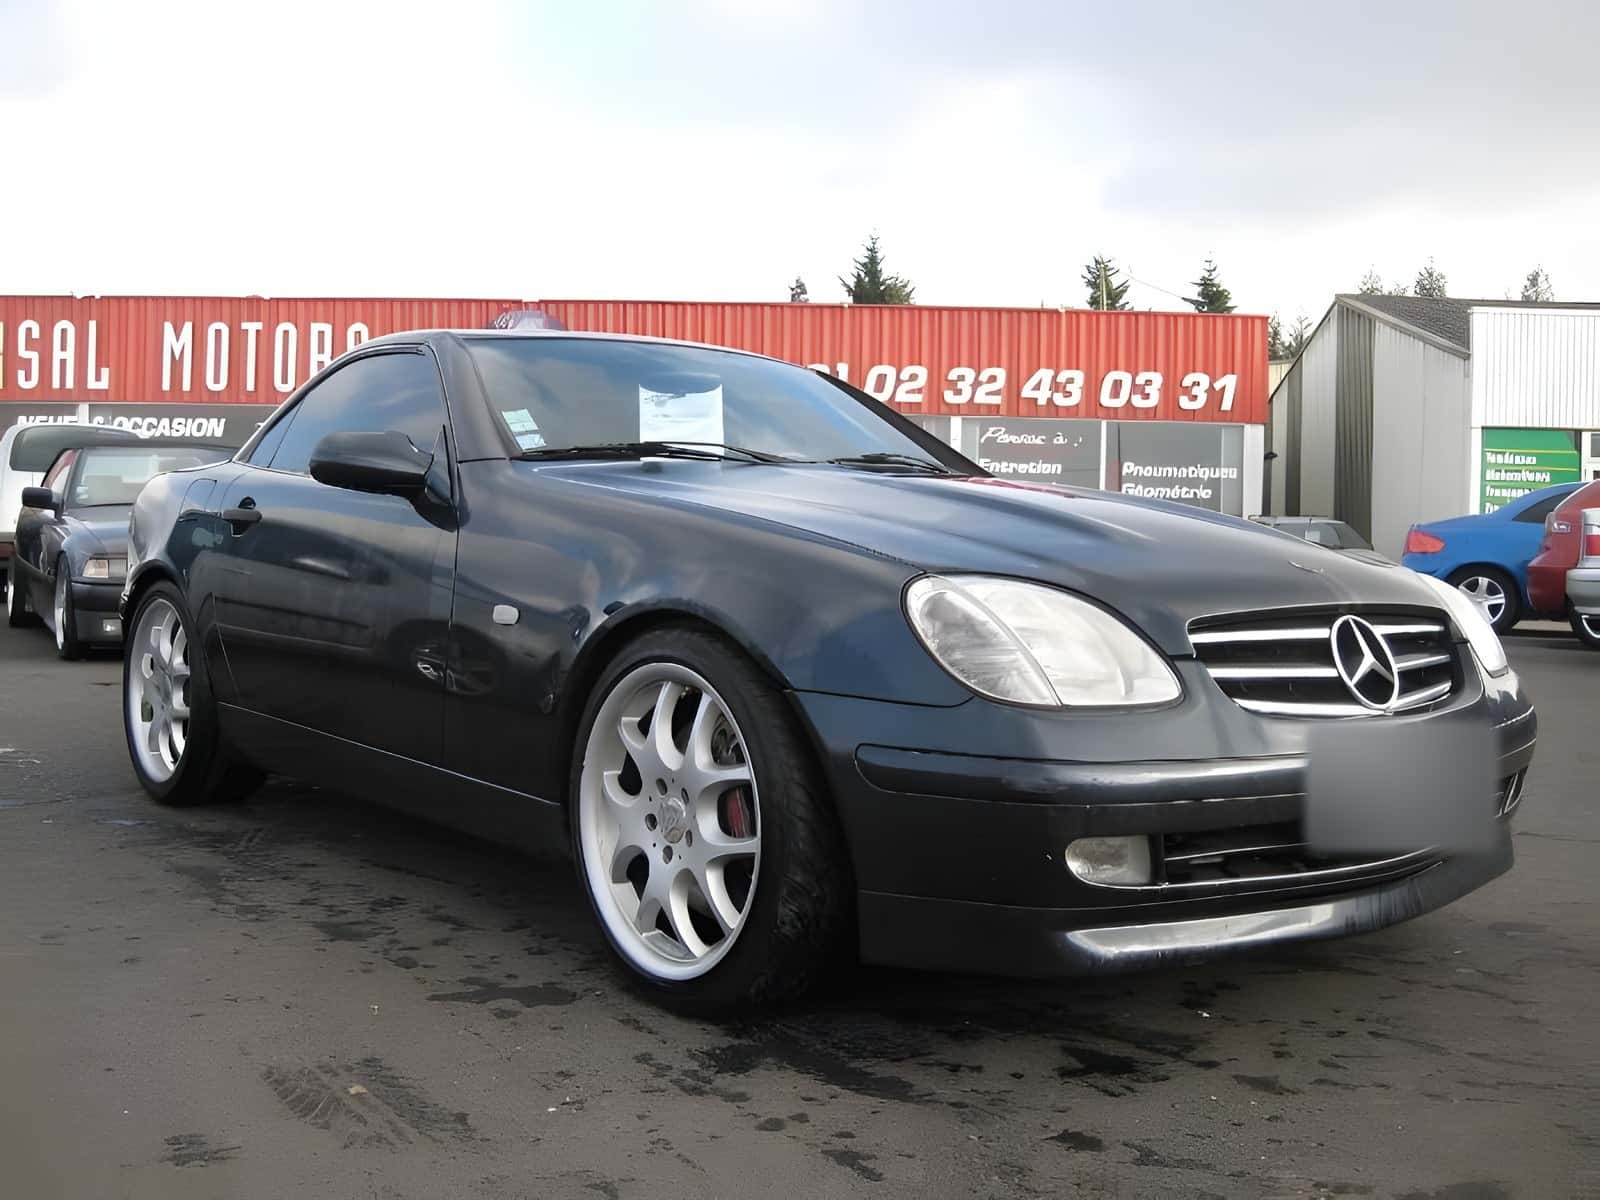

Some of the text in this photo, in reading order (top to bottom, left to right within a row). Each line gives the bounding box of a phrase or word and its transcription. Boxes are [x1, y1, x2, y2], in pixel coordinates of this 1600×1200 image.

[0, 320, 110, 390] SAL
[863, 364, 928, 403] 02
[943, 367, 1007, 405] 32
[1021, 368, 1085, 407] 43
[1099, 370, 1163, 409] 03
[1178, 372, 1238, 412] 31
[113, 416, 226, 438] OCCASION
